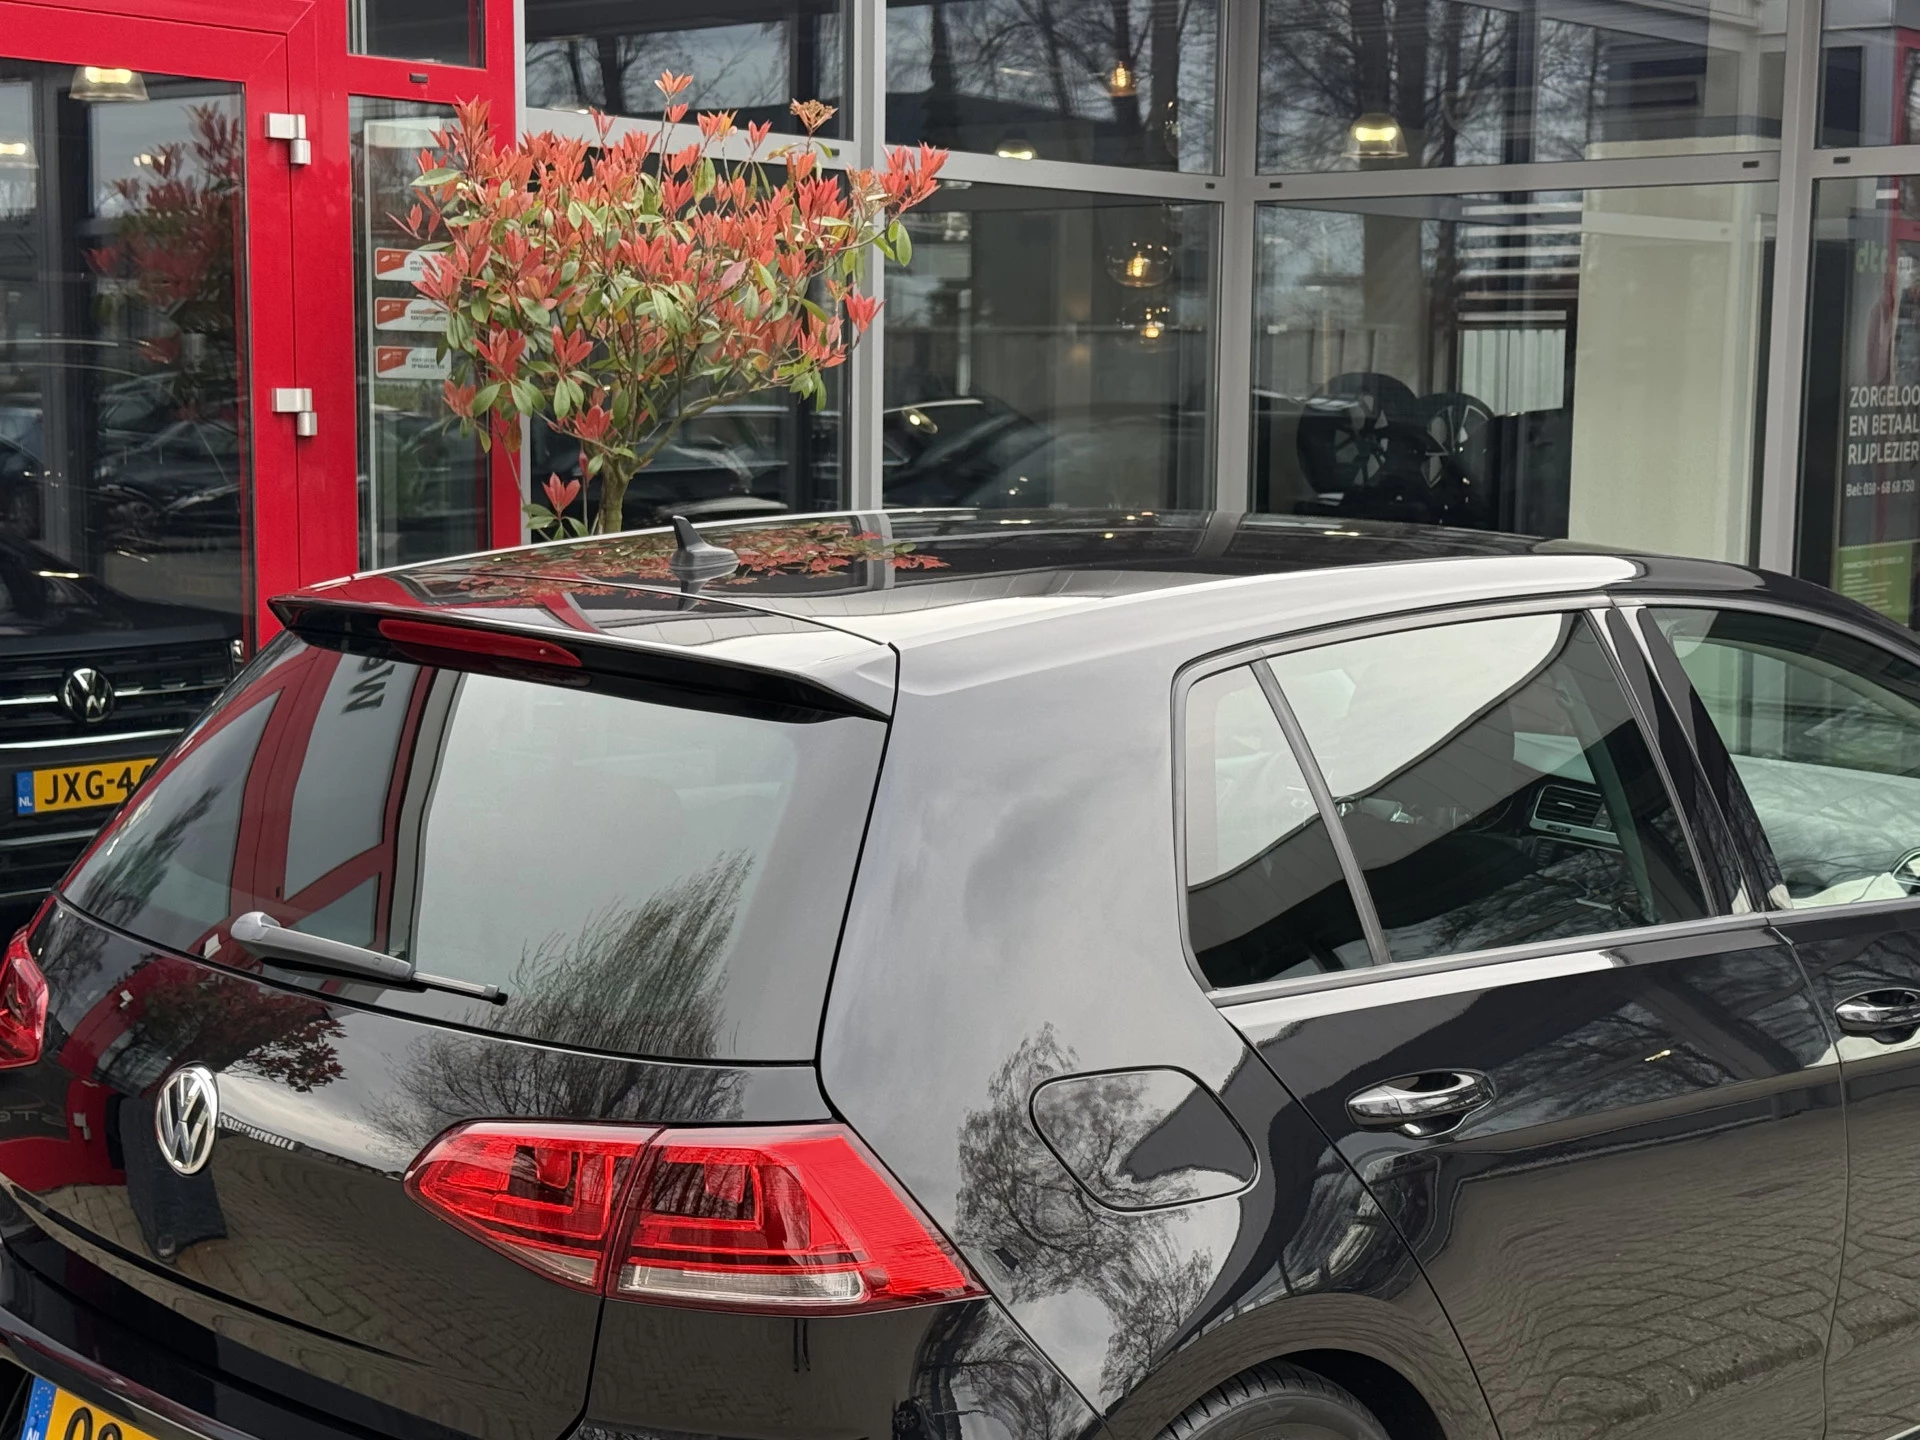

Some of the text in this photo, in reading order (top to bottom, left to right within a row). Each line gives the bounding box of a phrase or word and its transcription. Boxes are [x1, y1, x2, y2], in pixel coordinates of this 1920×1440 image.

[1849, 415, 1868, 437] EN
[1847, 441, 1920, 466] RIJPLEZIER
[1846, 482, 1863, 497] Bel:
[1863, 482, 1877, 496] 030
[1901, 479, 1915, 493] 750
[18, 796, 33, 807] NL
